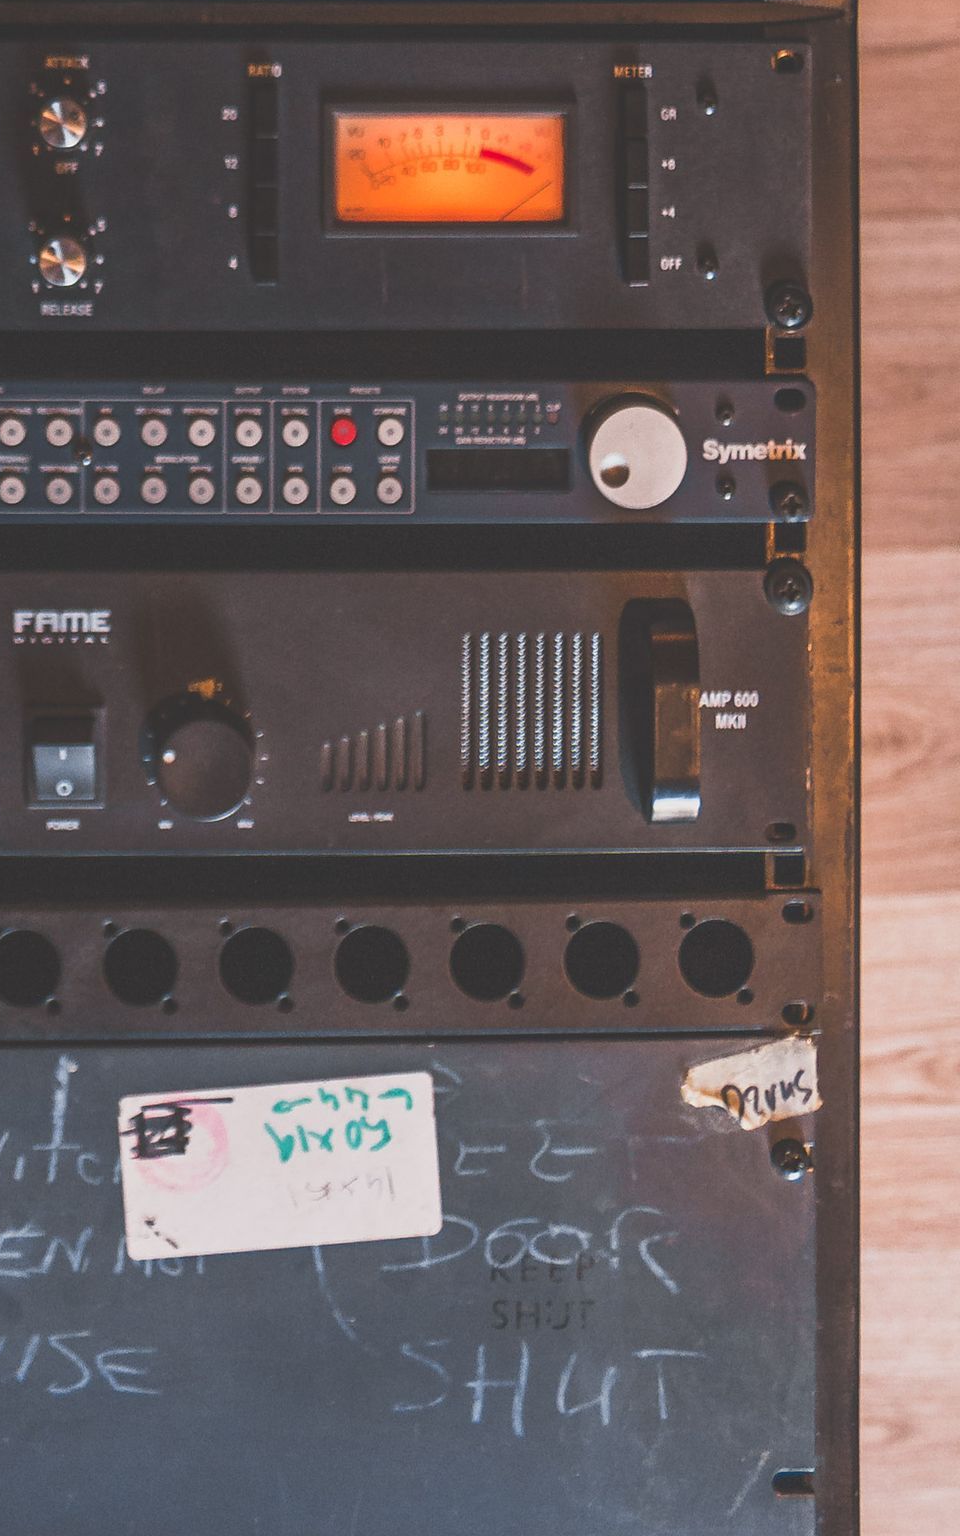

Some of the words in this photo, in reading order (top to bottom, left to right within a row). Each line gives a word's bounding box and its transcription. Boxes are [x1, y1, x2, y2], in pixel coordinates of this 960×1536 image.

[614, 65, 652, 78] METER
[661, 207, 676, 219] +4
[661, 258, 682, 271] OFF
[41, 304, 93, 316] RELEASE
[702, 439, 806, 464] Symetrix
[12, 609, 112, 633] FAME
[12, 636, 110, 644] DIGITAL
[698, 691, 731, 708] AMP
[733, 690, 759, 708] 600
[715, 713, 747, 730] MKII
[491, 1299, 597, 1332] SHUT
[391, 1338, 708, 1440] SHUT
